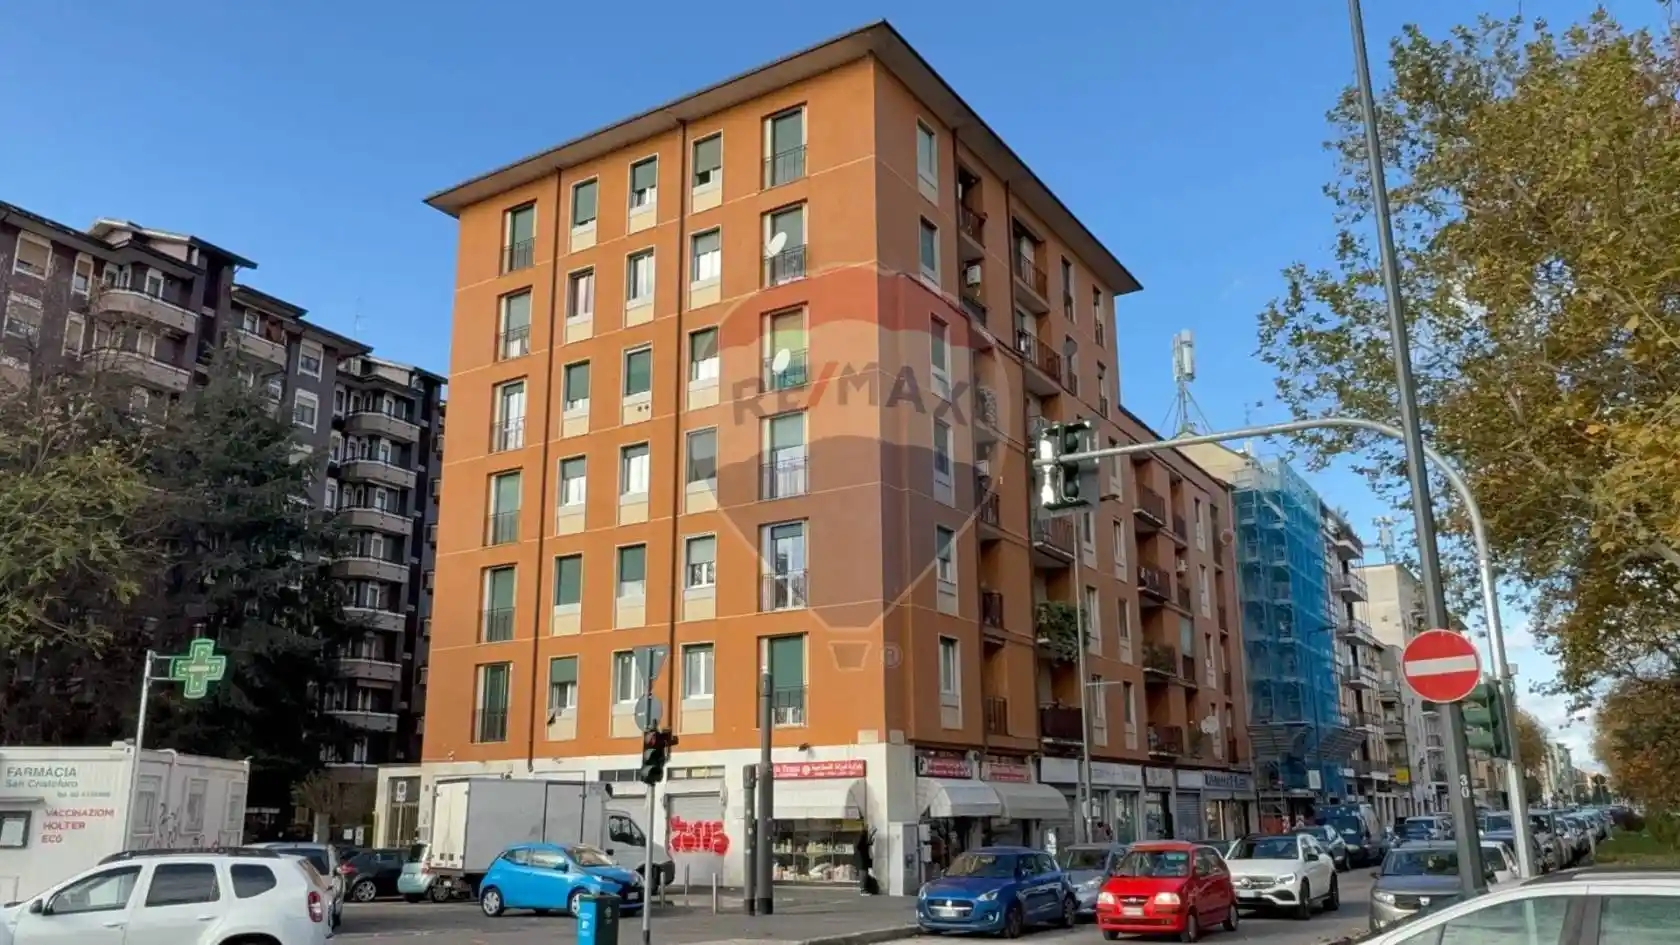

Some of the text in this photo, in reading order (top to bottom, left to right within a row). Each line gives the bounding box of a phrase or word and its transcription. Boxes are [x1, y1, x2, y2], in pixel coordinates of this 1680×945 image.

[7, 766, 77, 778] FARMACIA
[5, 779, 25, 788] San
[45, 808, 115, 817] VACCINAZIONI
[43, 820, 86, 830] HOLTER
